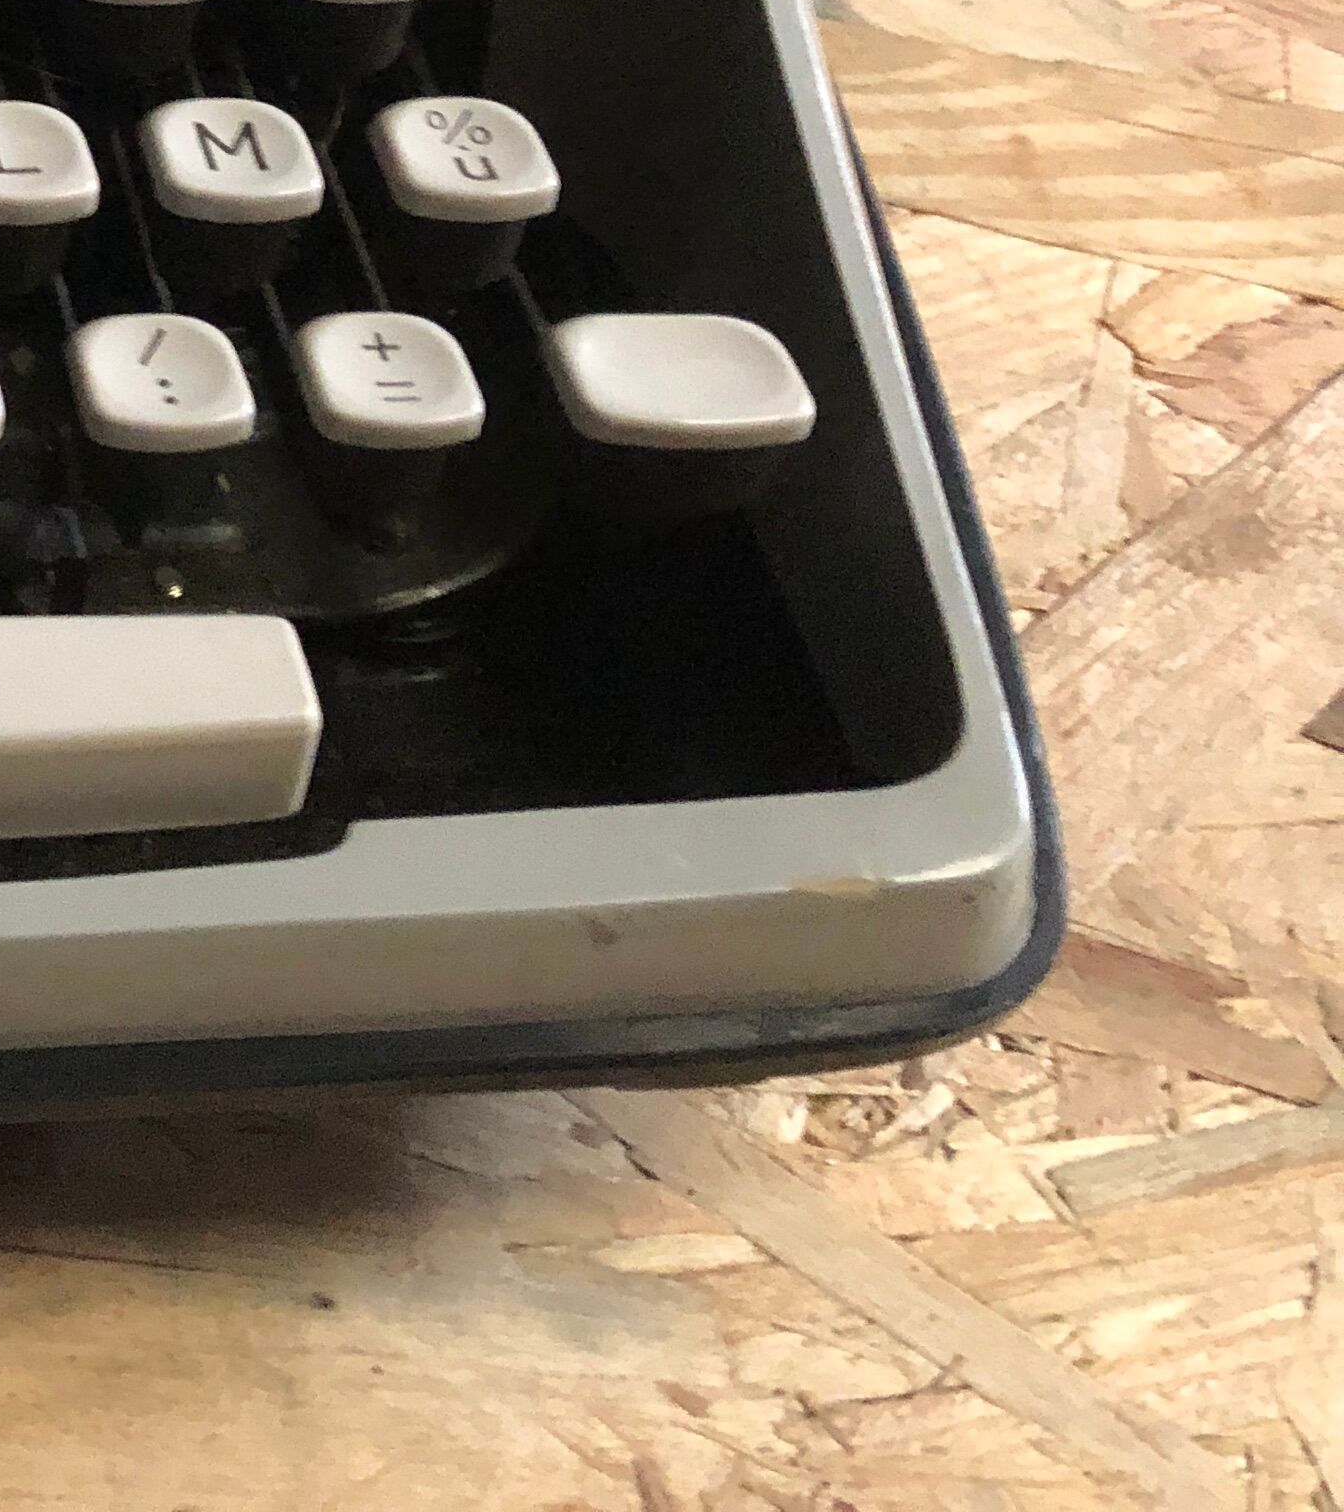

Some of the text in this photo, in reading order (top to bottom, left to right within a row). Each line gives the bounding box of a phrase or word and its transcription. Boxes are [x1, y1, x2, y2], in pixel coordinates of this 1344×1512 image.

[425, 110, 492, 146] %
[193, 121, 270, 172] M
[361, 332, 401, 362] +
[374, 380, 423, 403] =
